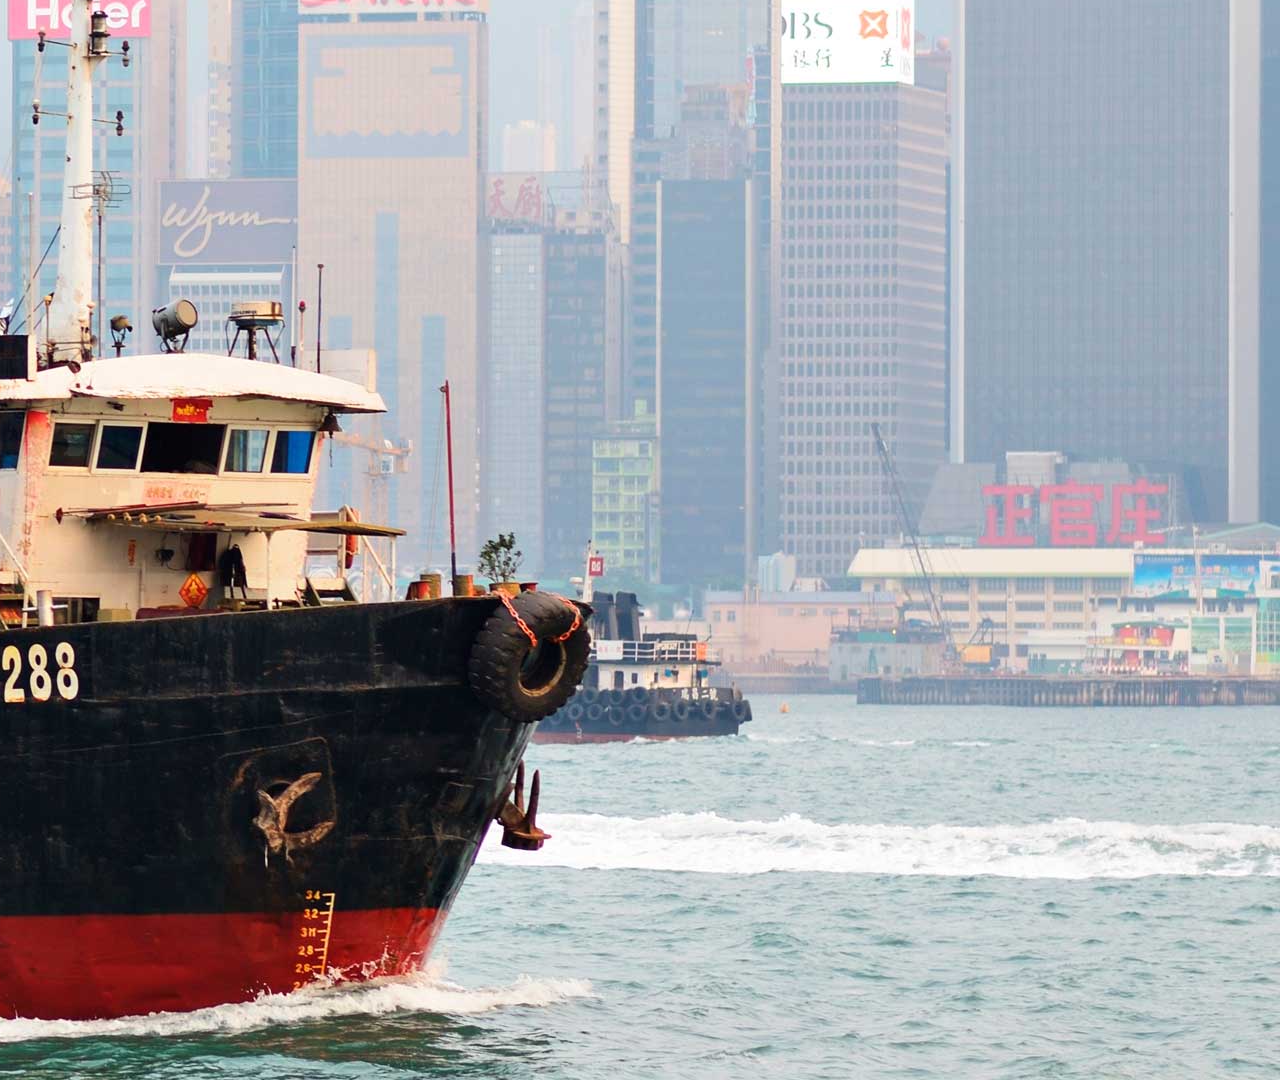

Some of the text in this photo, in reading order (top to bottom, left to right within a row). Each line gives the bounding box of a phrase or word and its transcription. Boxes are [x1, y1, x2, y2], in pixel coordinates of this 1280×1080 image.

[978, 478, 1168, 546] 正官庄
[2, 642, 79, 704] 288
